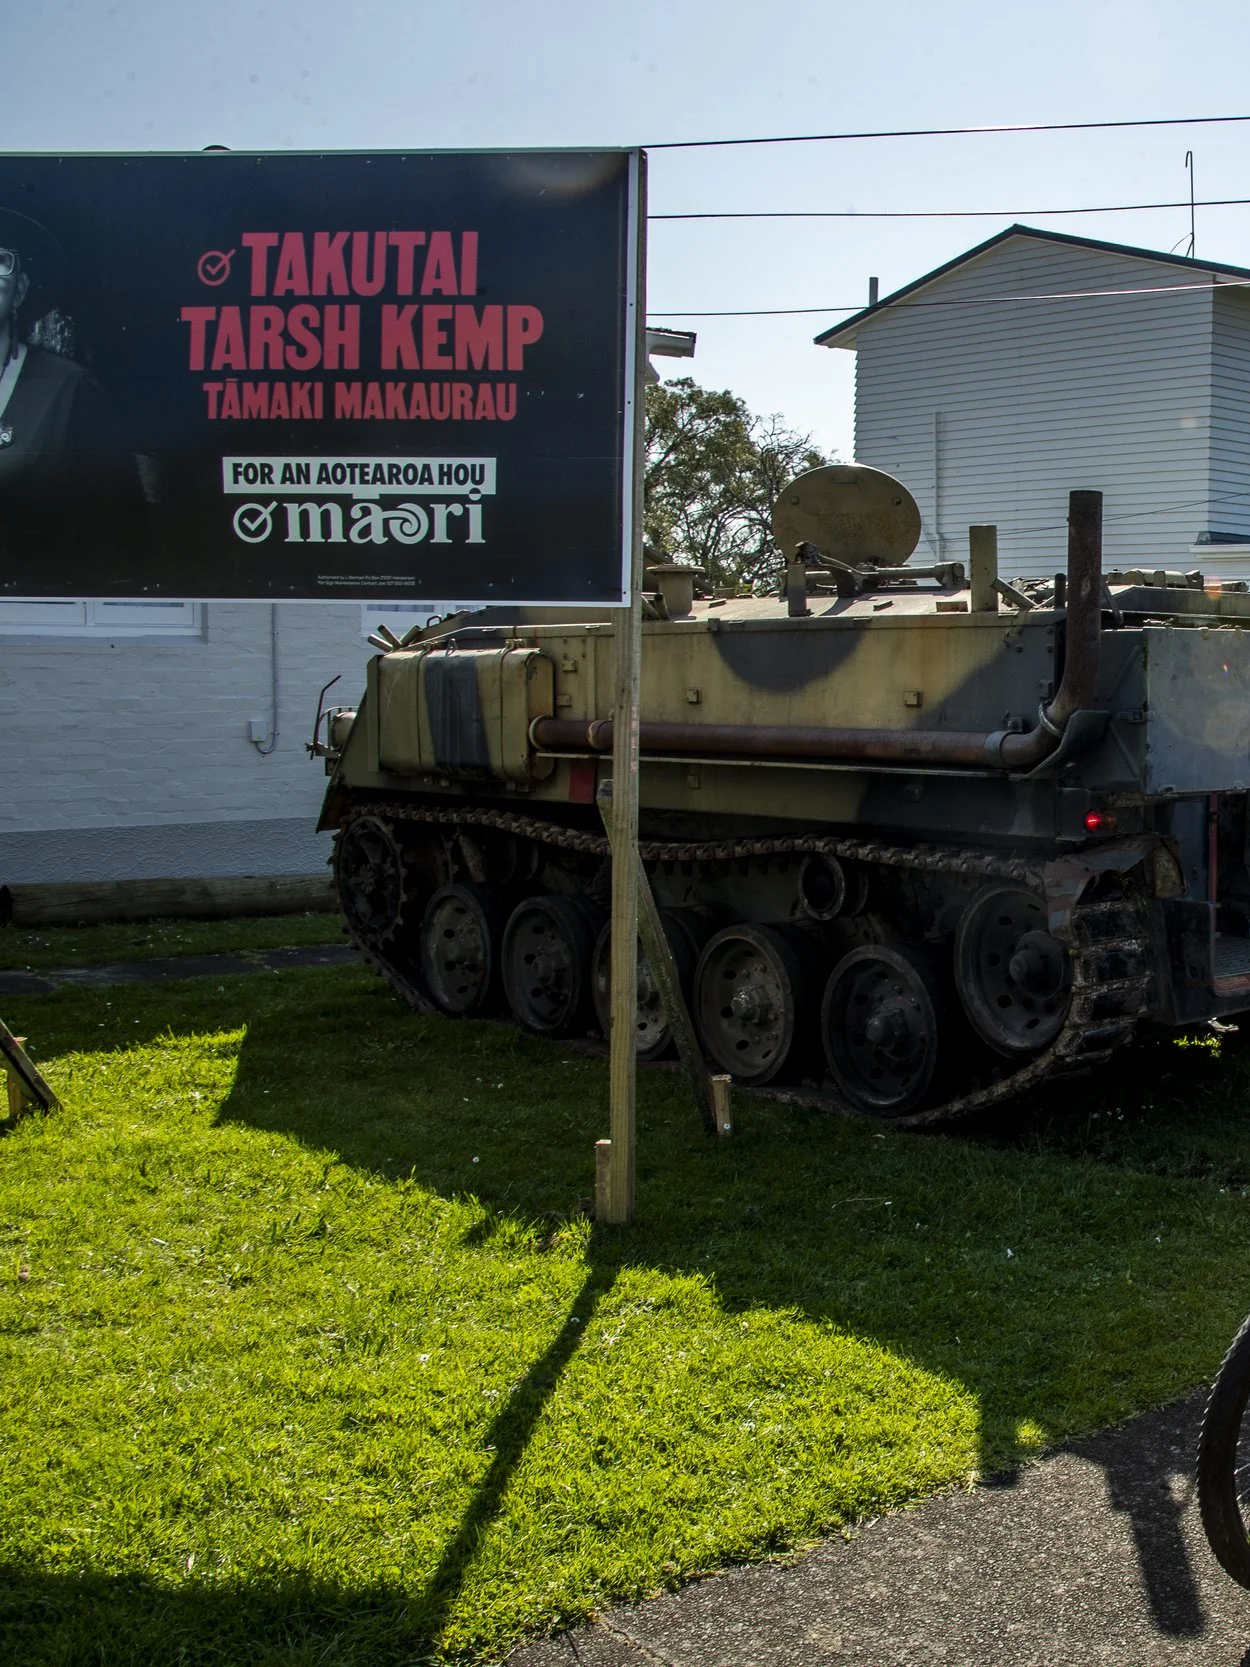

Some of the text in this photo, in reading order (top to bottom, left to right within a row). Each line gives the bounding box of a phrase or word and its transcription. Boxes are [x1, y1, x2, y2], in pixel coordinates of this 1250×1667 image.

[241, 231, 479, 297] TAKUTAI
[180, 303, 544, 371] TARSH KEMP
[203, 378, 517, 421] TĀMAKI MAKAURAU
[232, 462, 486, 486] FOR AN AOTEAROA HOU
